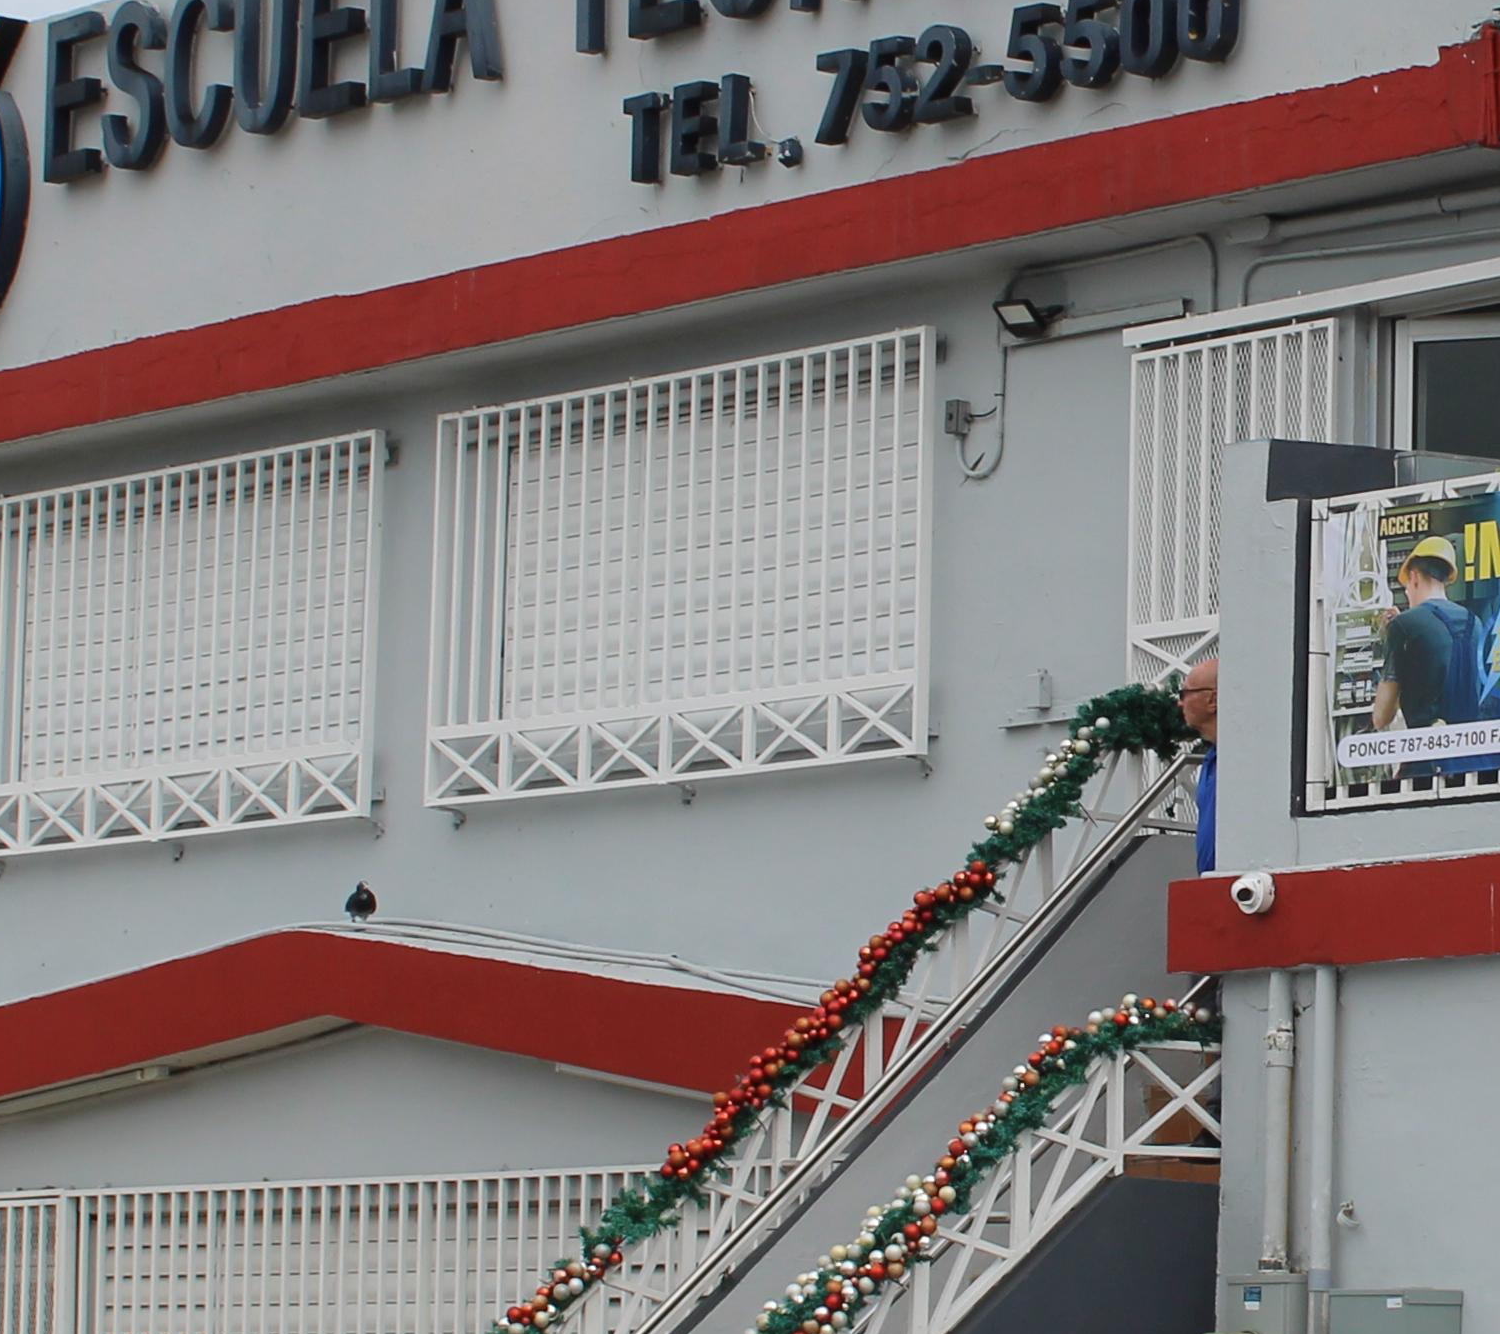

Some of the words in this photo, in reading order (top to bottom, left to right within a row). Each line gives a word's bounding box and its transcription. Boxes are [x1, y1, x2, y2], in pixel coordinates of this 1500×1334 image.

[622, 73, 804, 185] TEL.
[1380, 513, 1418, 537] ACCET
[1348, 739, 1396, 758] PONCE
[1400, 730, 1487, 753] 787-843-7100
